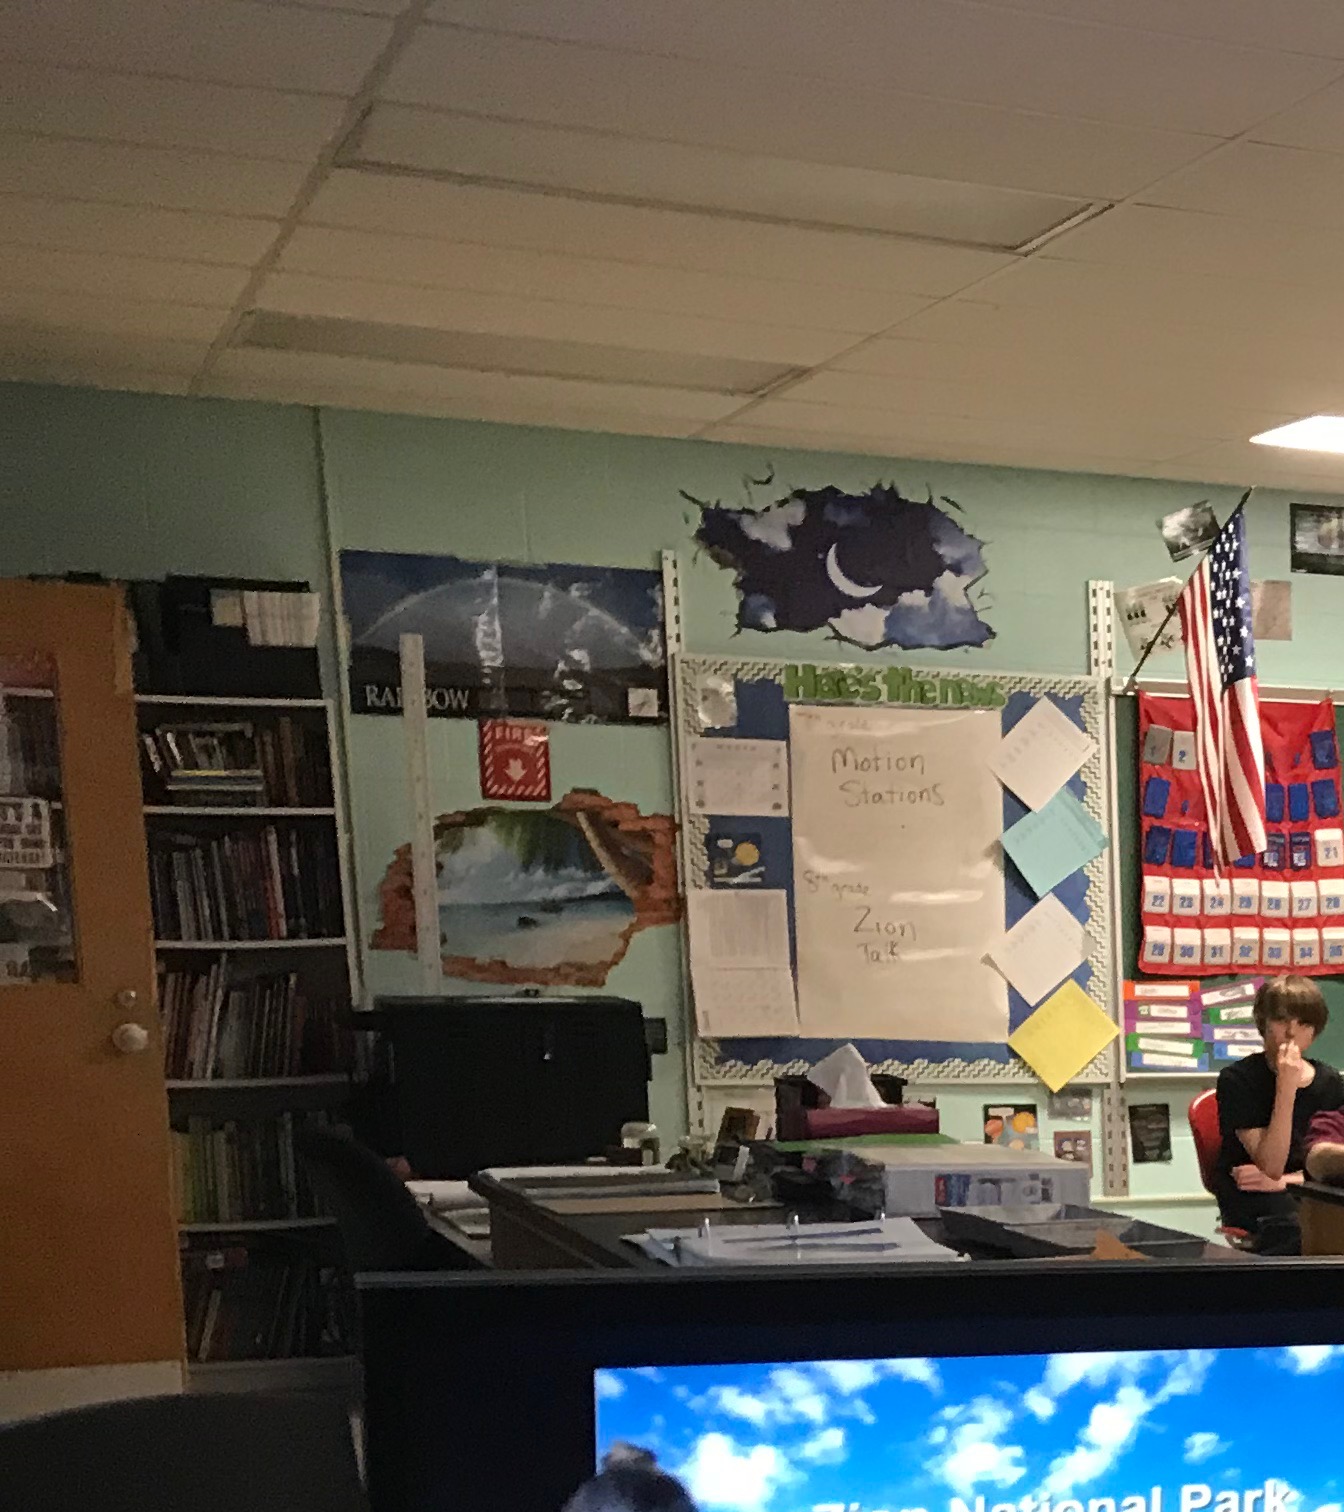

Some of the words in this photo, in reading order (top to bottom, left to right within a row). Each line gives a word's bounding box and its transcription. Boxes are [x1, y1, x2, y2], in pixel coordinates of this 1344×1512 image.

[831, 746, 925, 775] Motion
[838, 779, 945, 807] Stations
[853, 905, 918, 942] Zion
